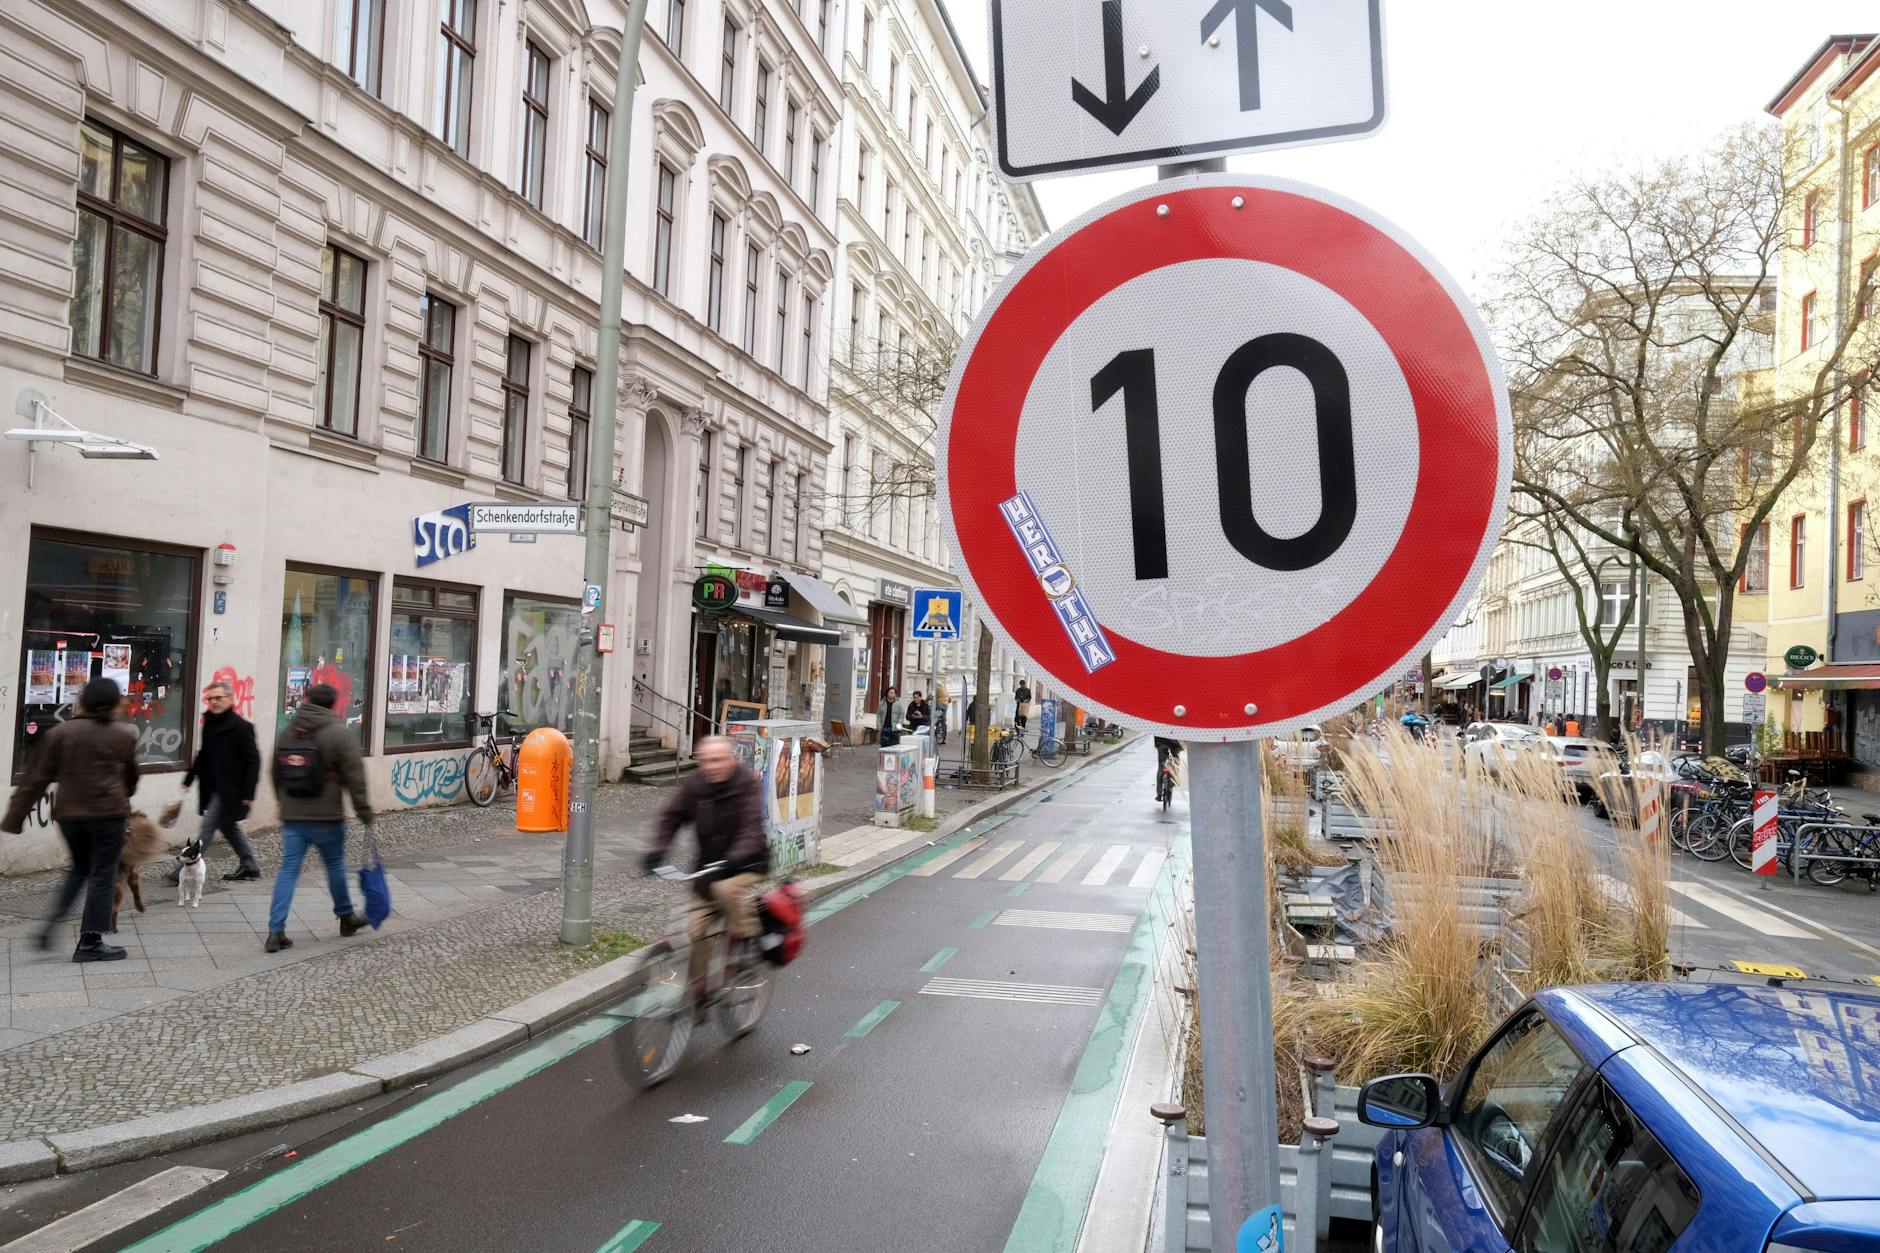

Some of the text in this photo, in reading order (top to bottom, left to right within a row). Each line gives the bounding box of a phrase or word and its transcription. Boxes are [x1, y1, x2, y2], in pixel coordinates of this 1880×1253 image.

[1091, 333, 1357, 580] 10
[476, 508, 576, 527] Schenkendorfstraße
[703, 583, 726, 600] PR
